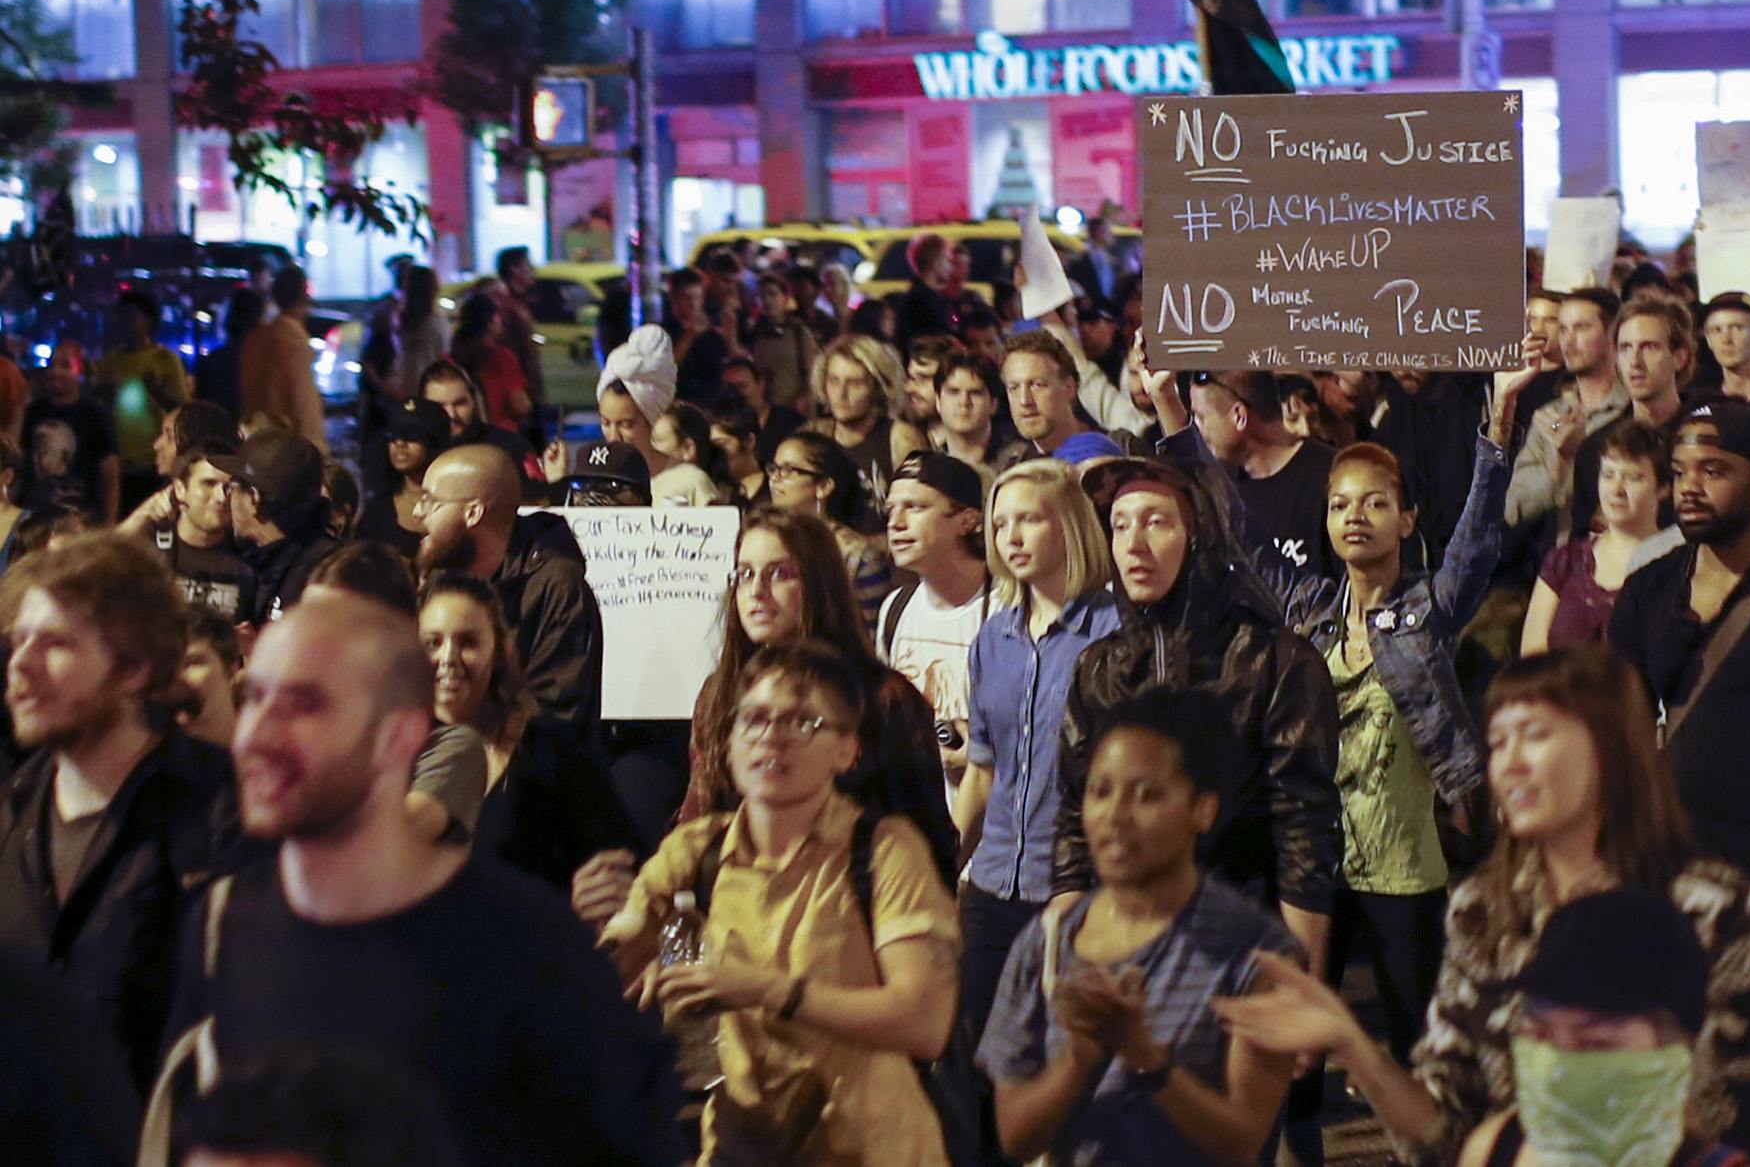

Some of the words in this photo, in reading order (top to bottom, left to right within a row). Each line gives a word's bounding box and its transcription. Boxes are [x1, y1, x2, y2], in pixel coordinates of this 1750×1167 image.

[914, 48, 1060, 99] WHOLE
[1060, 42, 1204, 95] FOODS
[1279, 36, 1401, 86] RKET
[1157, 283, 1236, 336] NO
